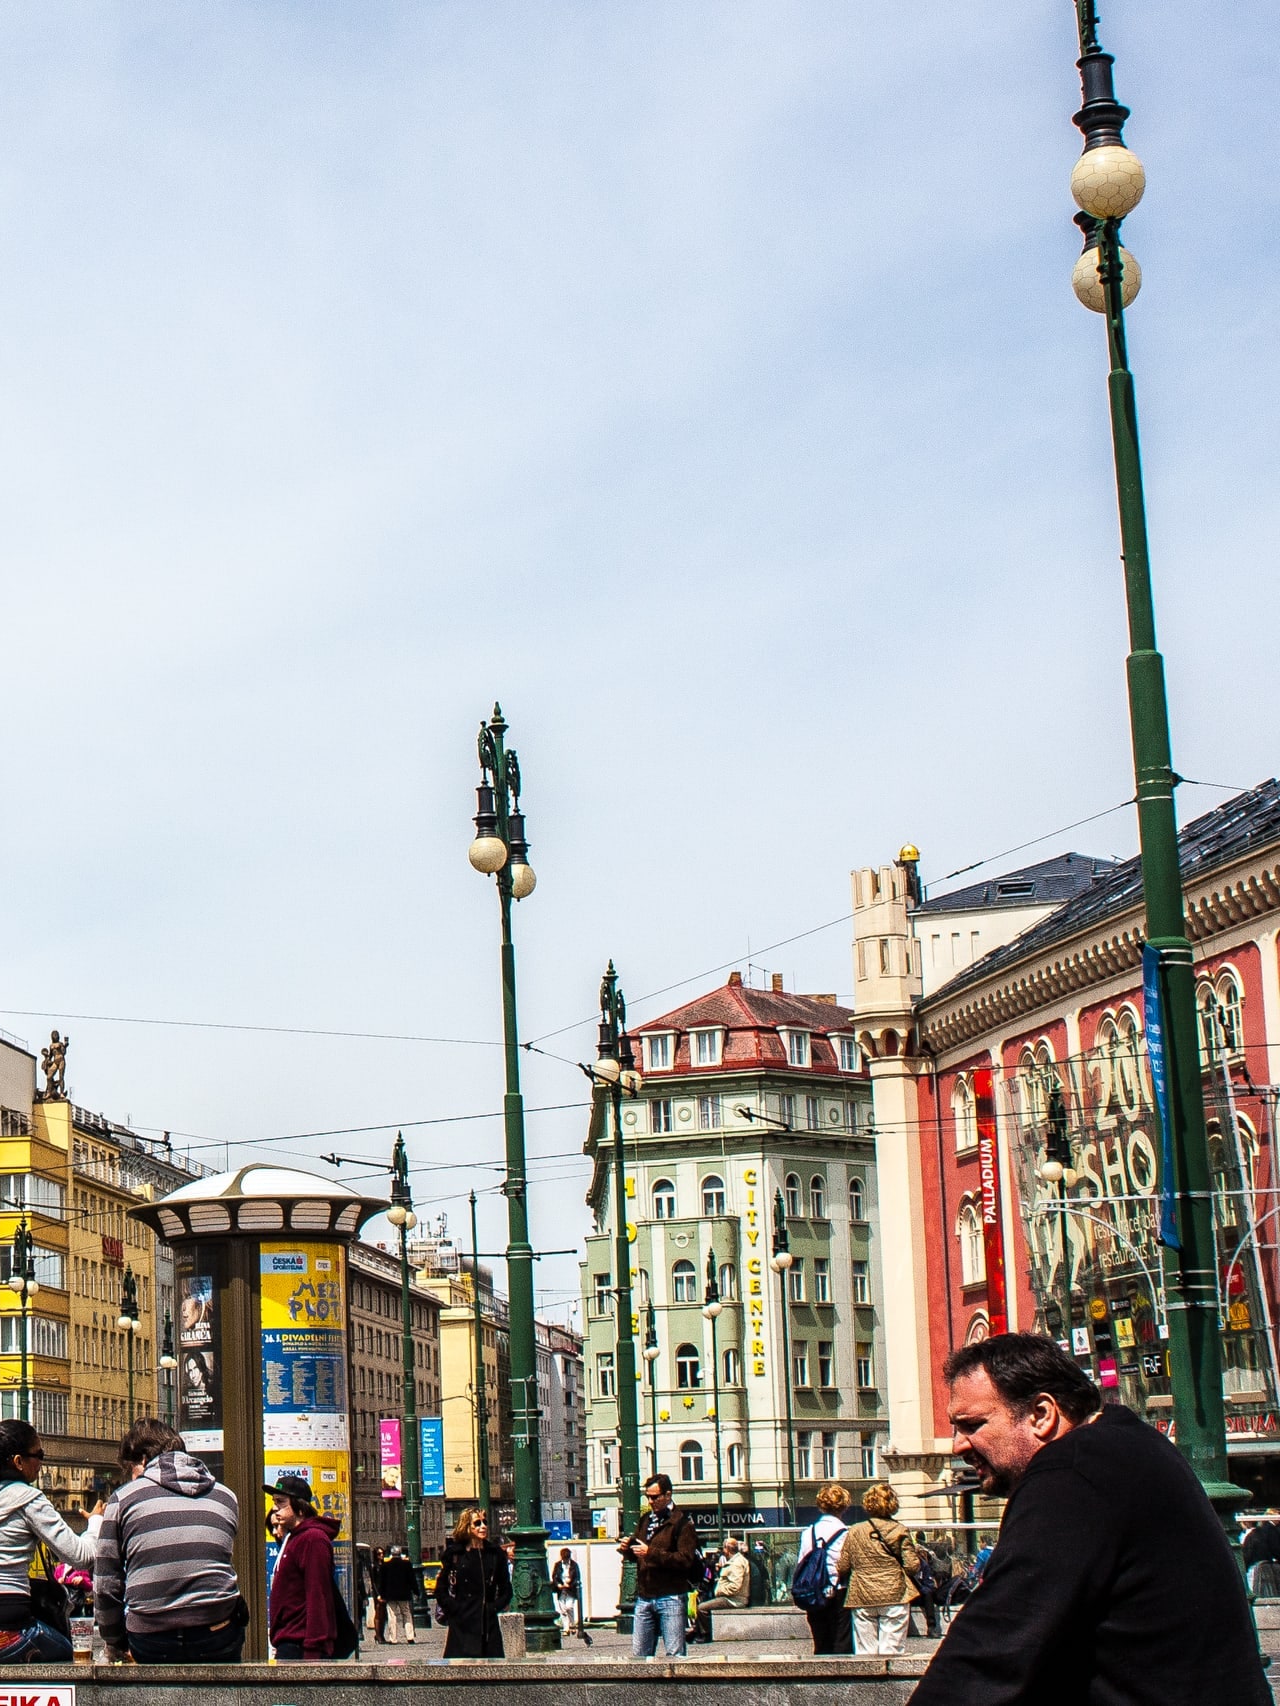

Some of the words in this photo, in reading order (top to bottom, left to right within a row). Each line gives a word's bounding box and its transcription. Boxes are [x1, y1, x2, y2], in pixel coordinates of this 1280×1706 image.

[980, 1138, 997, 1225] PALLADIUM
[743, 1168, 760, 1248] CITY
[272, 1256, 296, 1265] ČESKÁ
[292, 1278, 341, 1299] MEZ
[747, 1257, 766, 1376] CENTRE
[277, 1468, 301, 1477] ČESKÁ
